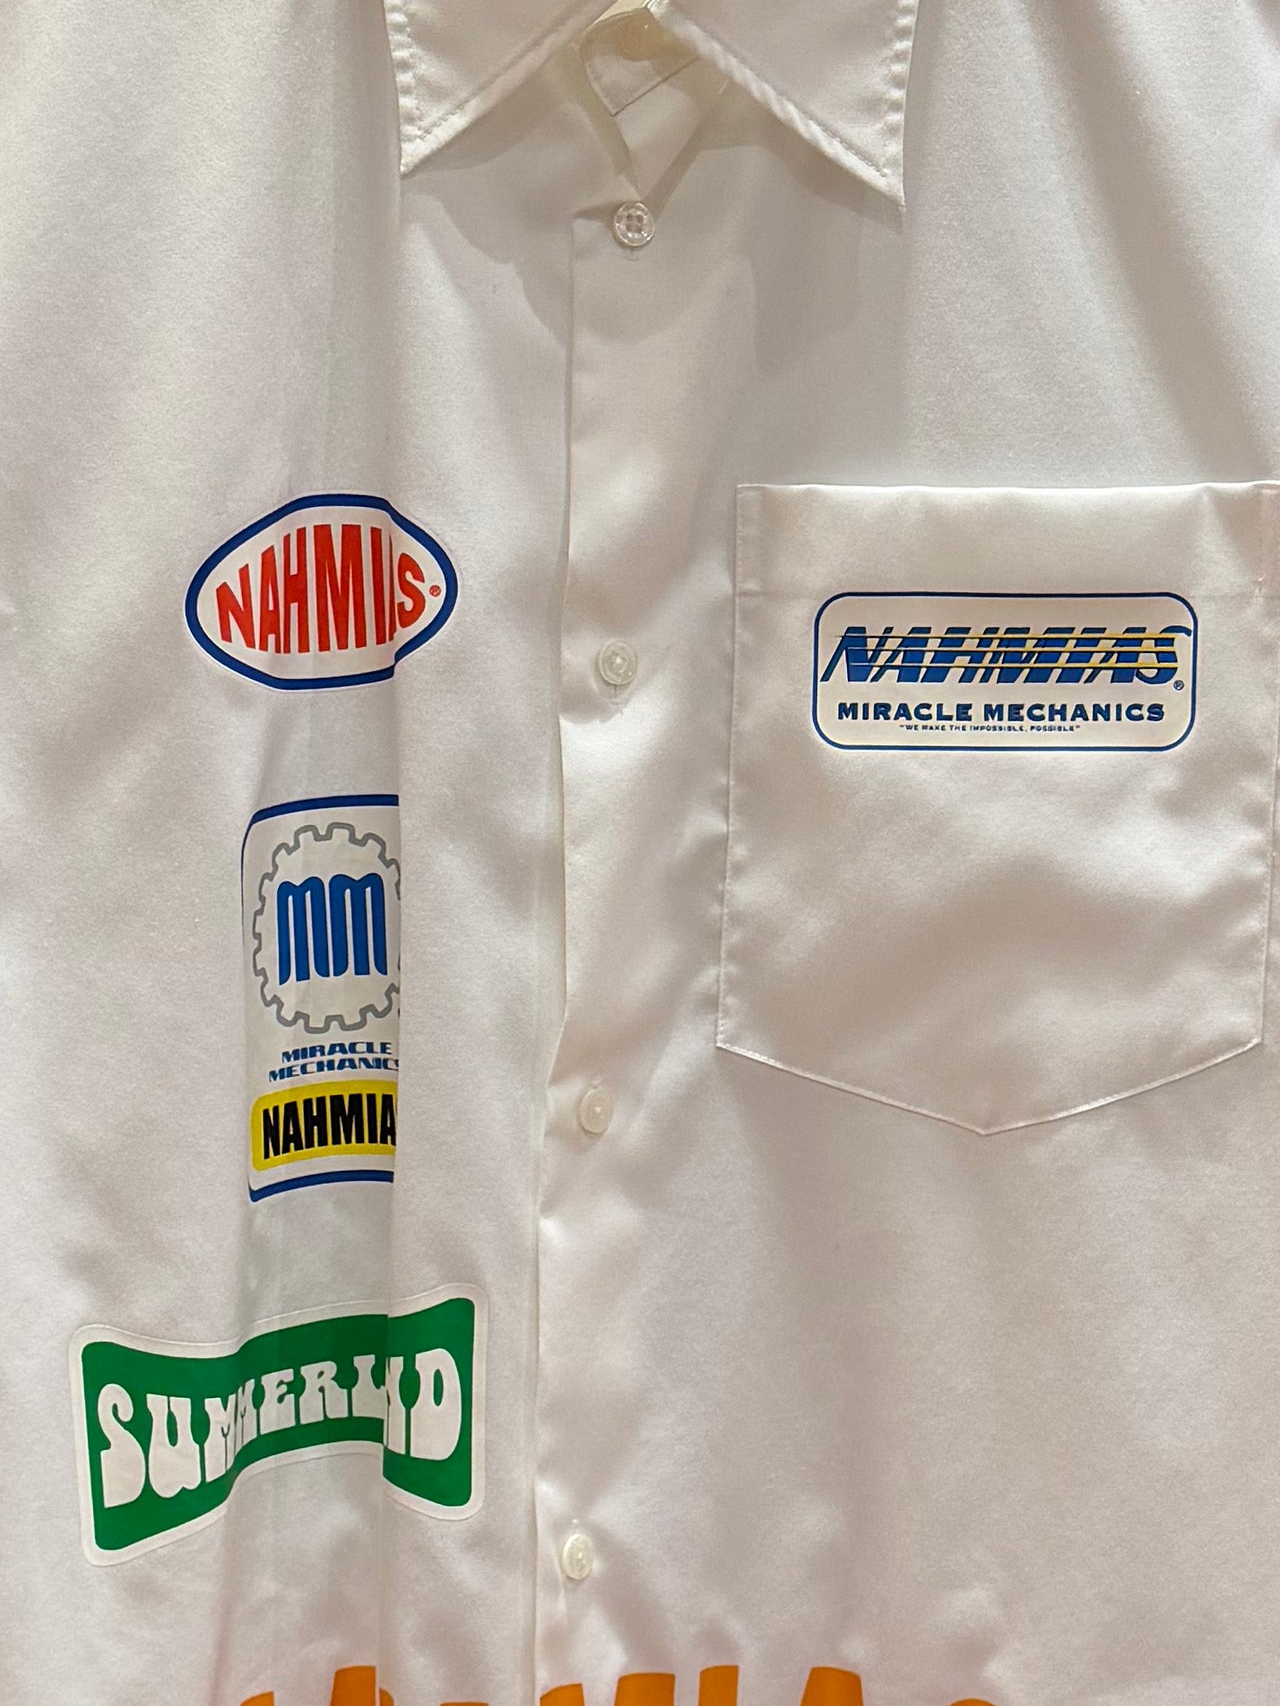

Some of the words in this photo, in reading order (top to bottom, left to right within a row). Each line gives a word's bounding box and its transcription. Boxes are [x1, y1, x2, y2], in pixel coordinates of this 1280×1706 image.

[820, 626, 1192, 684] NAHMIAS
[838, 702, 973, 722] MIRACLE
[984, 702, 1165, 722] MECHANICS
[282, 1042, 392, 1063] MIRACLE
[269, 1058, 398, 1082] MECHANIC
[263, 1093, 396, 1160] NAHMIA
